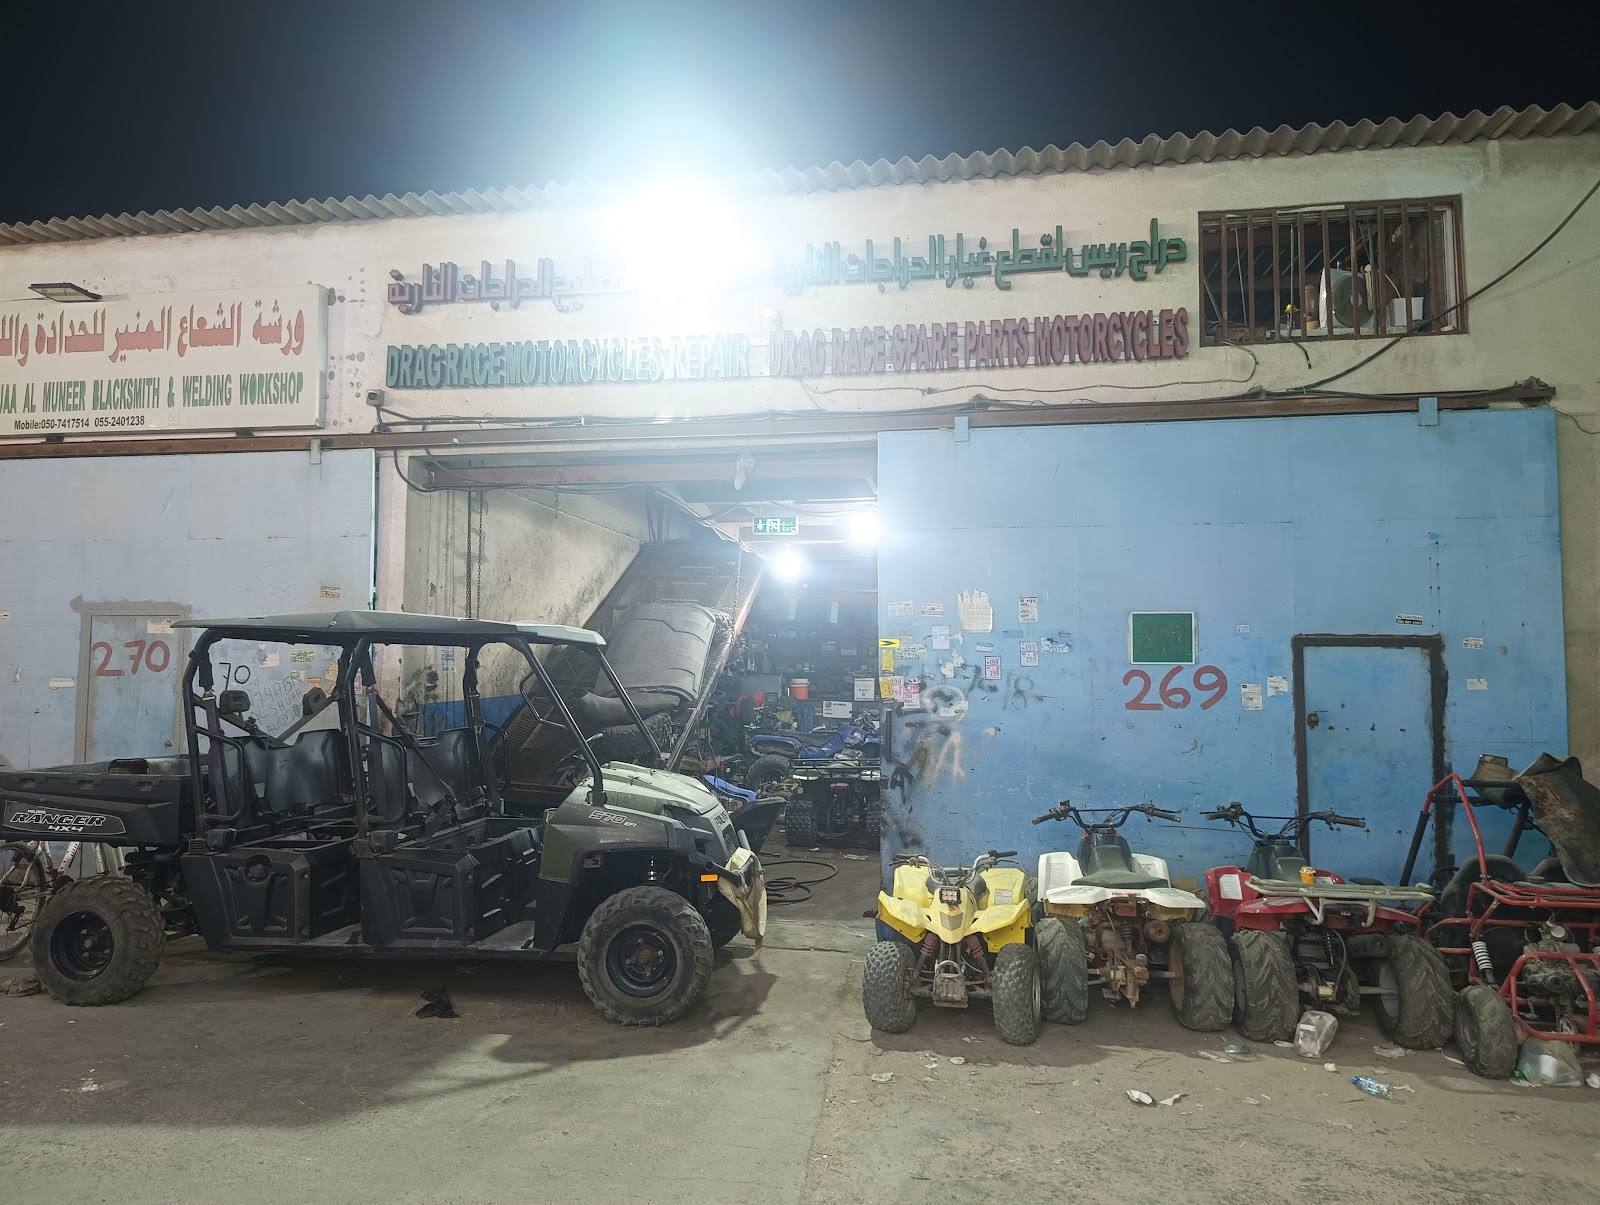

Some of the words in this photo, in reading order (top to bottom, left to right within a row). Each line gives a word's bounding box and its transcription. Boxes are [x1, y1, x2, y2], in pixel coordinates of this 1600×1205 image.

[841, 233, 945, 294] الدراجات
[946, 232, 992, 290] غيار
[995, 225, 1063, 290] لقطع
[1066, 243, 1127, 279] ريس
[1129, 218, 1188, 281] دراج
[388, 261, 457, 315] النارية
[457, 257, 553, 312] الدراجات
[35, 308, 106, 357] للحدادة
[109, 305, 172, 363] المنير
[177, 301, 243, 358] الشعاع
[253, 299, 305, 356] ورشة
[769, 329, 826, 377] DRAG
[831, 325, 887, 375] RACE
[892, 321, 959, 373] SPARE
[964, 316, 1030, 369] PARTS
[1034, 306, 1189, 366] MOTORCYCLES
[386, 343, 445, 388] DRAG
[446, 341, 502, 387] RACE
[505, 337, 664, 385] MOTORCYCLES
[665, 332, 750, 380] REPAIR
[23, 382, 37, 413] AL
[42, 381, 86, 412] MUNEER
[92, 377, 160, 410] BLACKSMITH
[167, 376, 175, 408] &
[182, 374, 232, 407] WELDING
[239, 371, 304, 406] WORKSHOP
[94, 415, 145, 428] 055-2401238
[91, 640, 170, 677] 270
[1122, 665, 1228, 711] 269
[10, 812, 107, 827] RANGER
